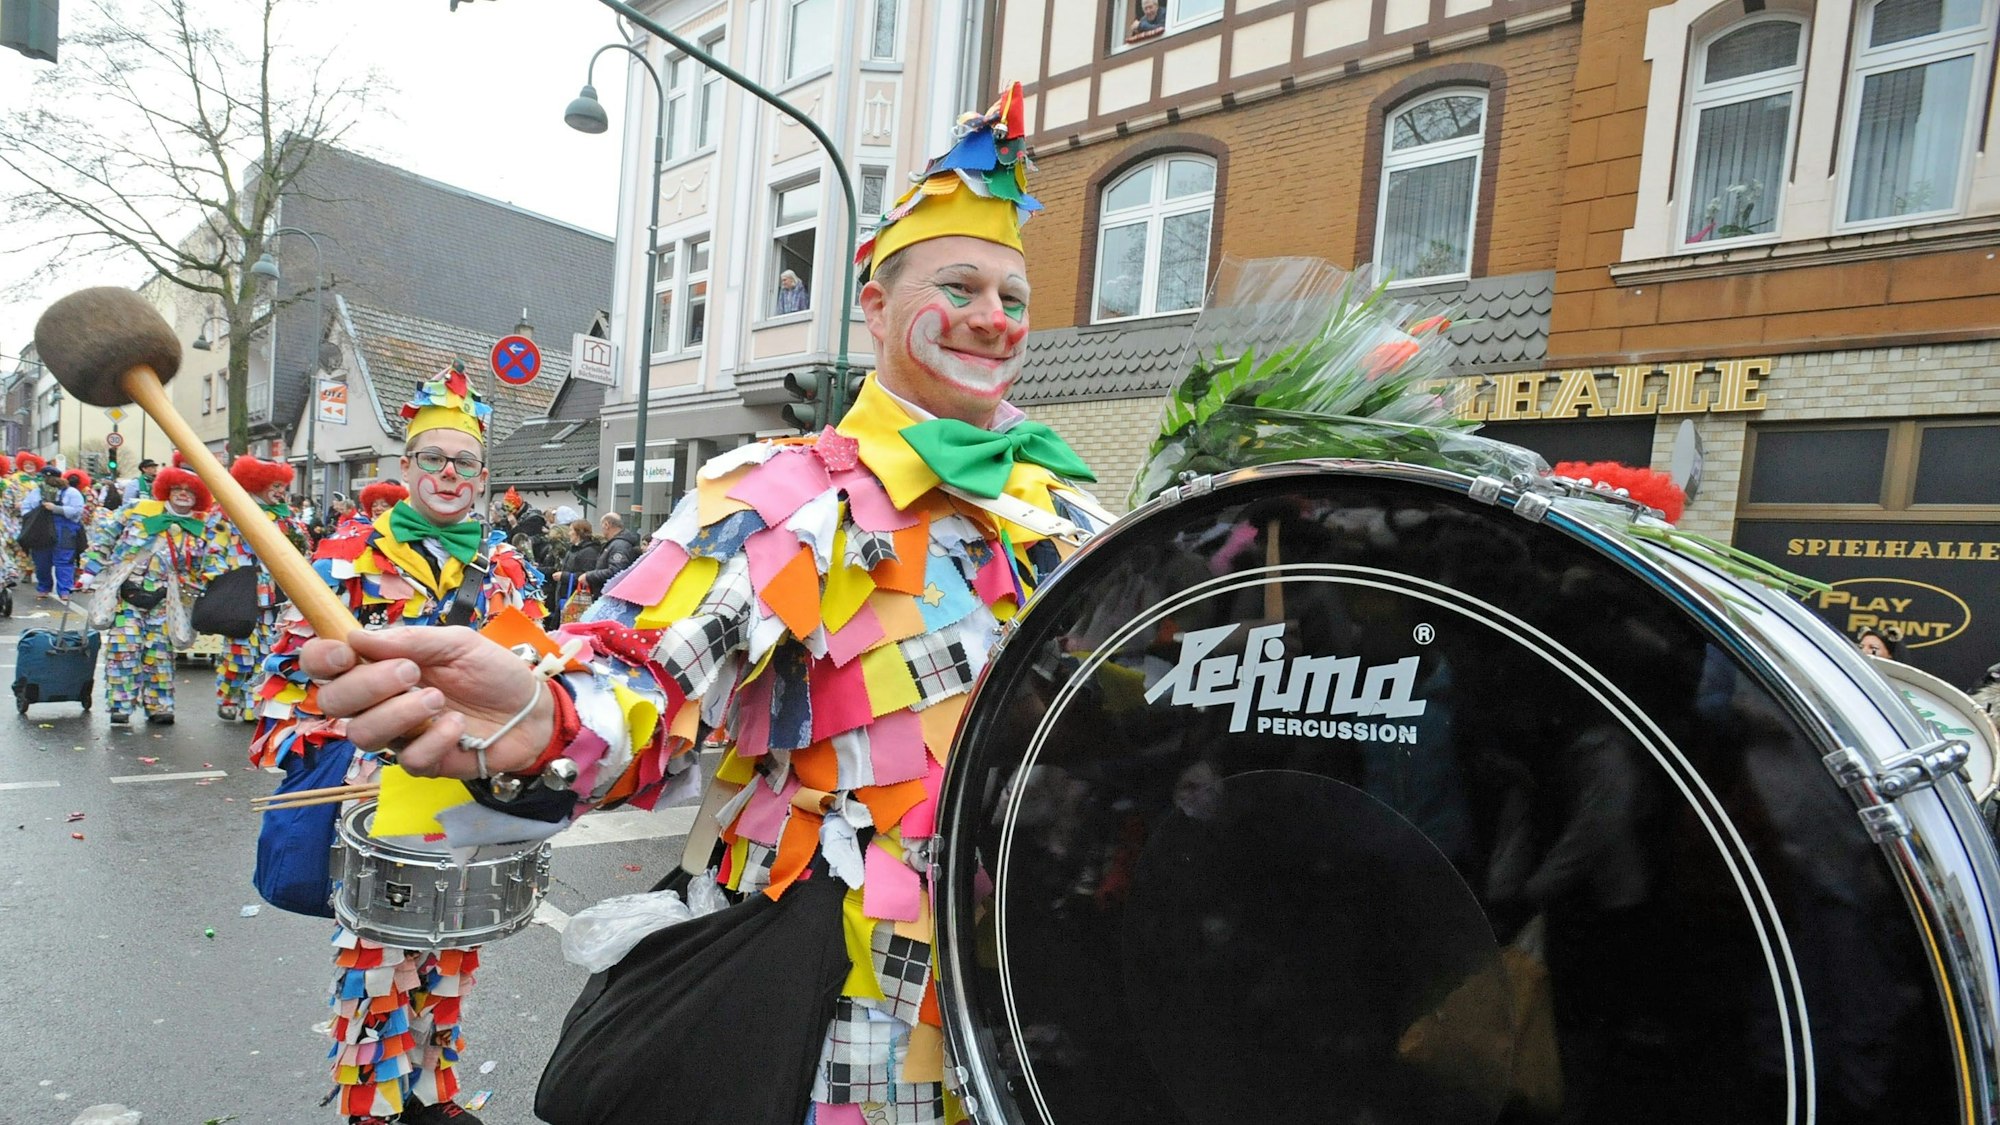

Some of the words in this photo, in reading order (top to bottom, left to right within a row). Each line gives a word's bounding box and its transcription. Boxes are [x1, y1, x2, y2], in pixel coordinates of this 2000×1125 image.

[110, 436, 120, 444] 30
[1787, 538, 2000, 561] SPIELHALLE
[1818, 590, 1913, 613] PLAY
[1143, 622, 1427, 733] Lefima
[1257, 716, 1418, 744] PERCUSSION
